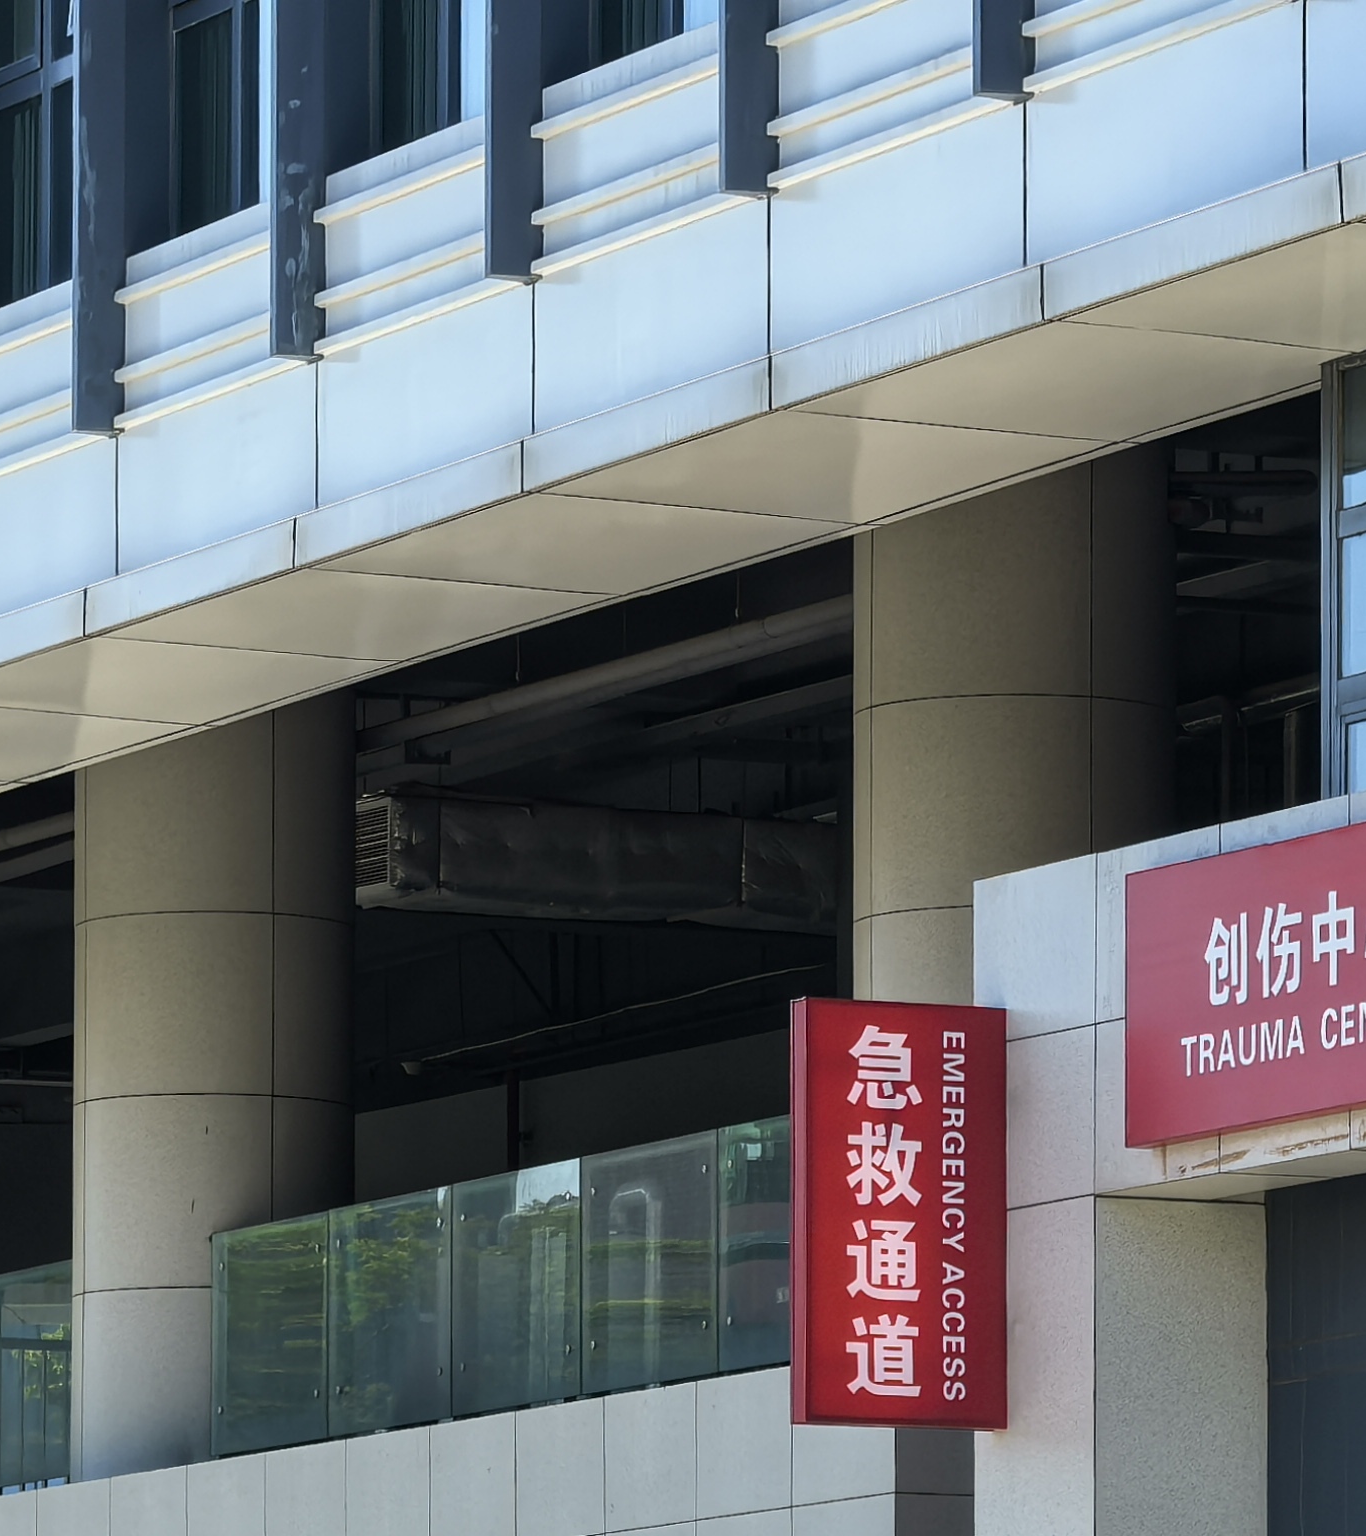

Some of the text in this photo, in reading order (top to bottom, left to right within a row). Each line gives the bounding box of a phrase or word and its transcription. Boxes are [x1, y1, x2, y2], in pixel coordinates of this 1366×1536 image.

[846, 1025, 923, 1397] 急救通道
[942, 1031, 966, 1401] EMERGENCY ACCESS
[1180, 1015, 1305, 1077] TRAUMA
